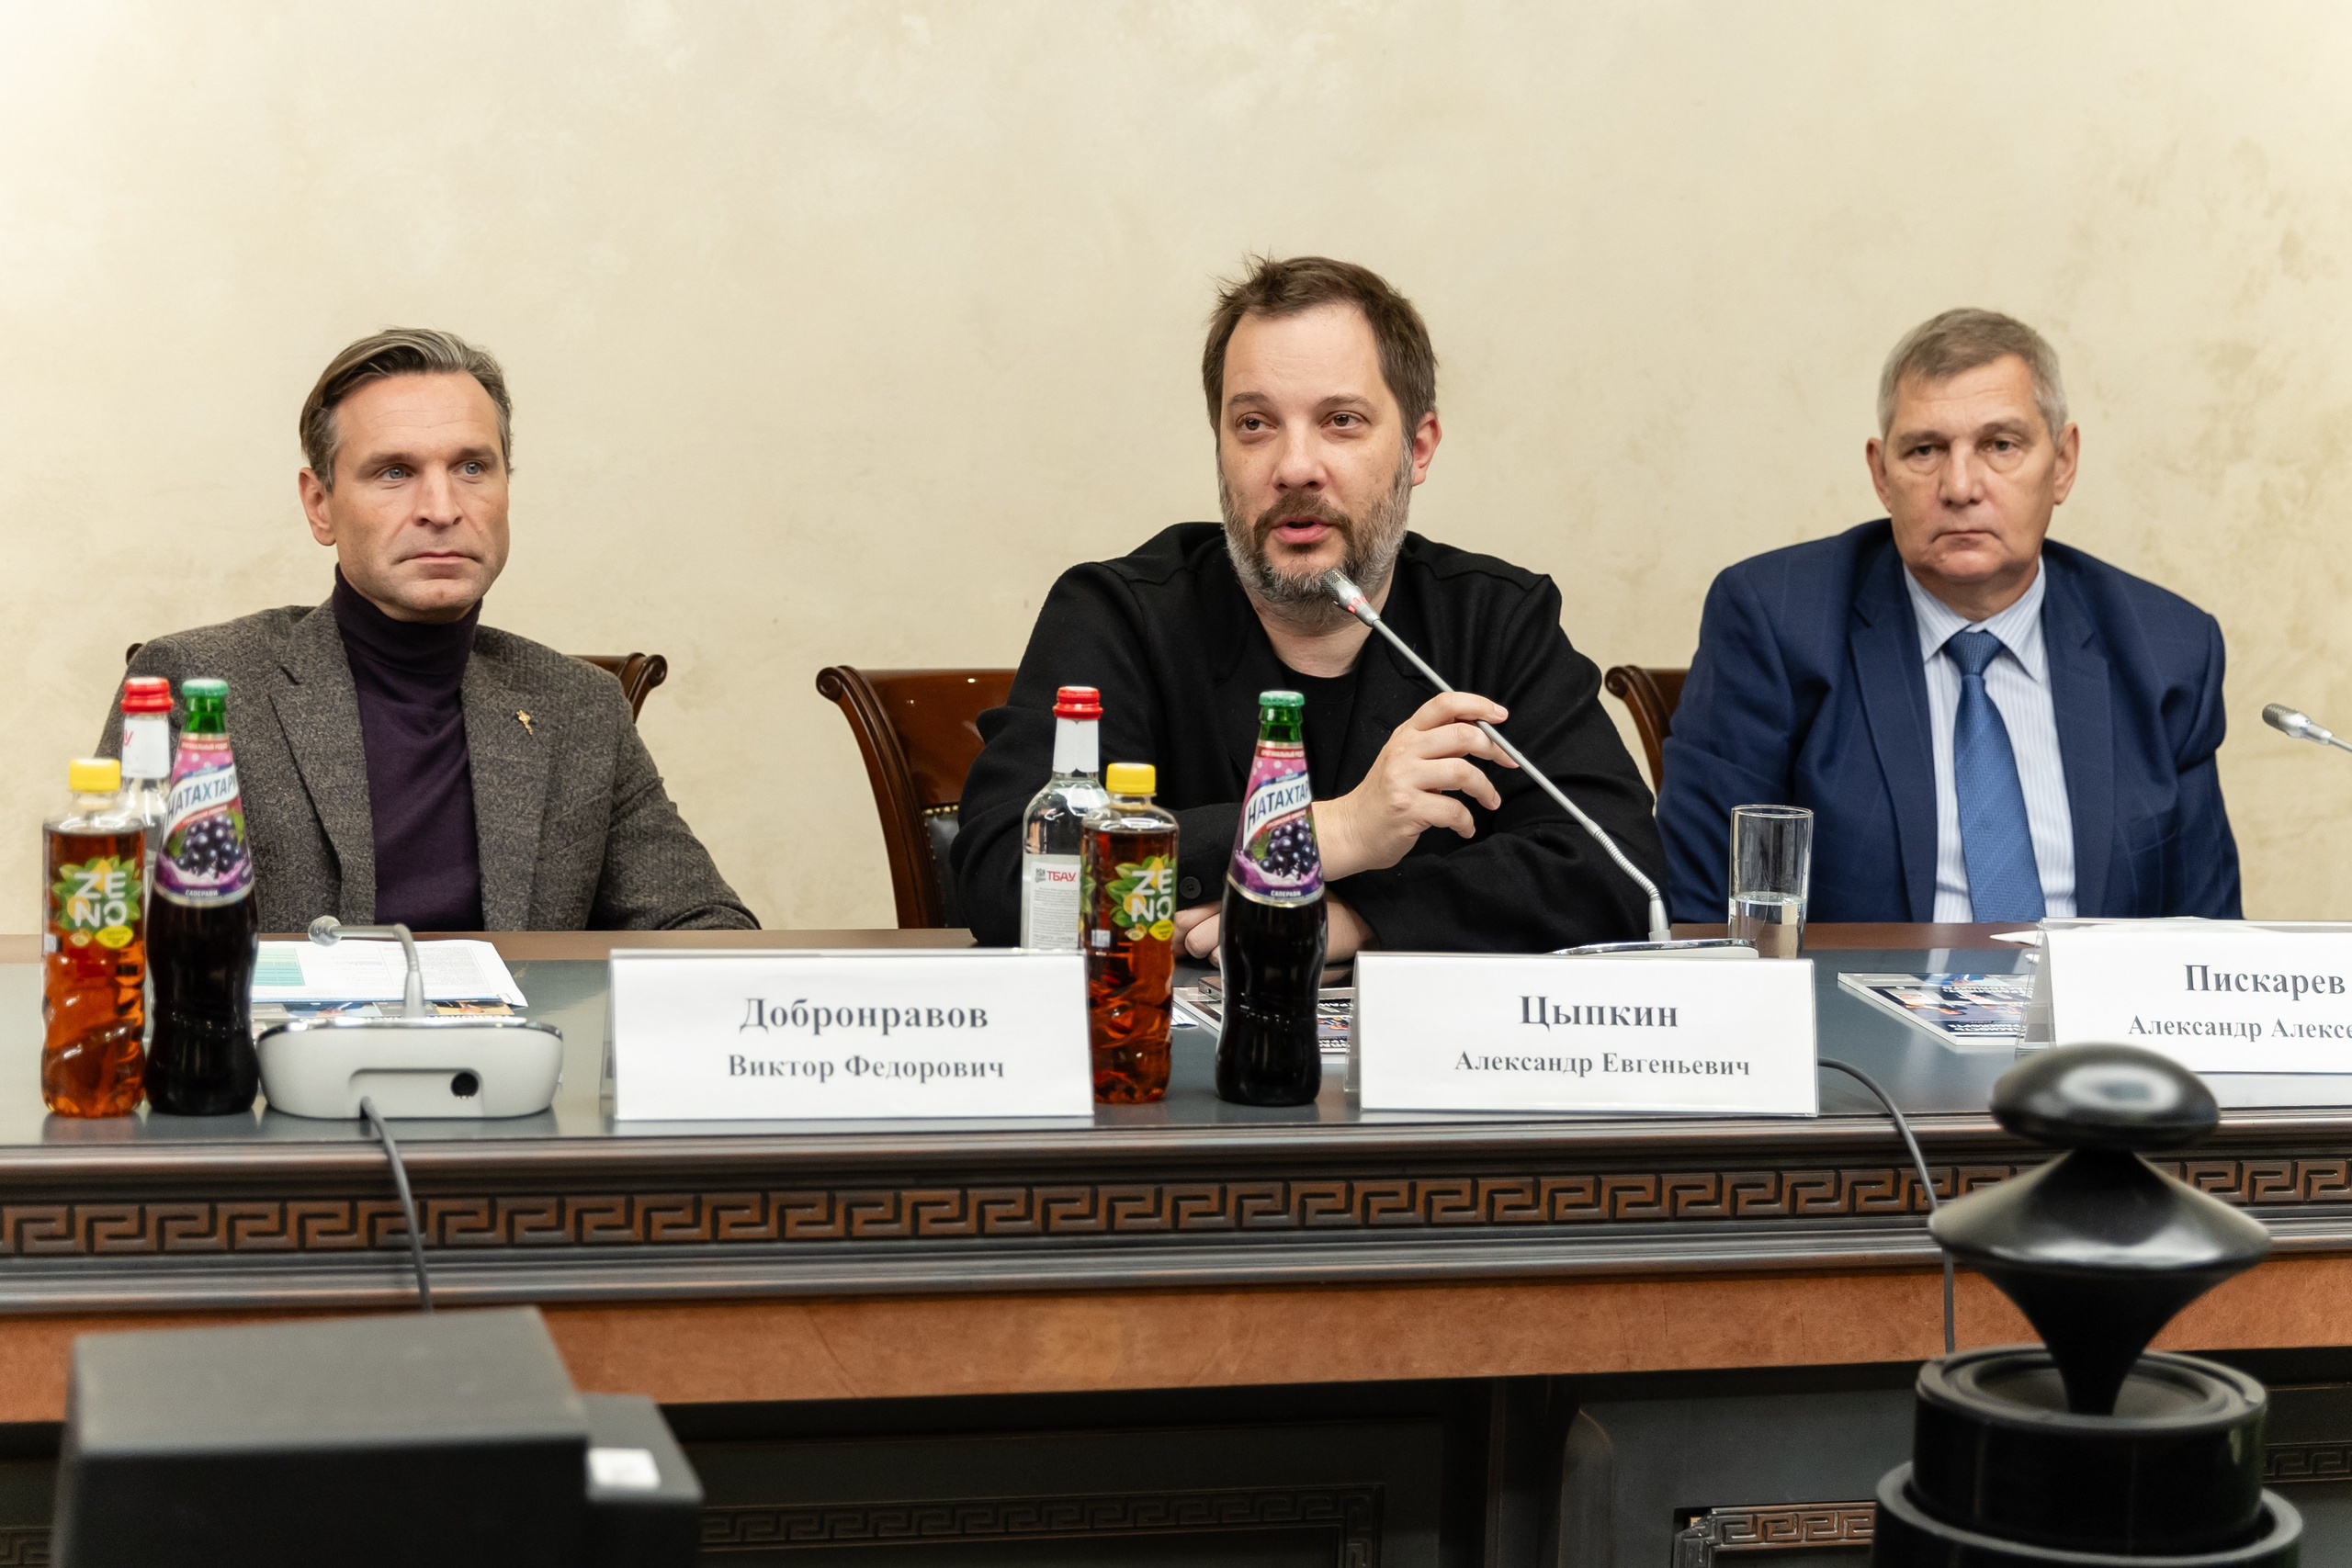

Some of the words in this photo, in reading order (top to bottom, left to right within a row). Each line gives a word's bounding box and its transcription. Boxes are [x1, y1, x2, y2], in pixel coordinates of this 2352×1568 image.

[2184, 964, 2346, 1001] Пискарев
[740, 998, 989, 1036] Добронравов
[1520, 996, 1679, 1032] Цыпкин
[2128, 1015, 2262, 1043] Александр
[729, 1055, 834, 1084] Виктор
[844, 1055, 1004, 1084] Федорович
[1454, 1051, 1593, 1078] Александр
[1602, 1053, 1750, 1077] Евгеньевич
